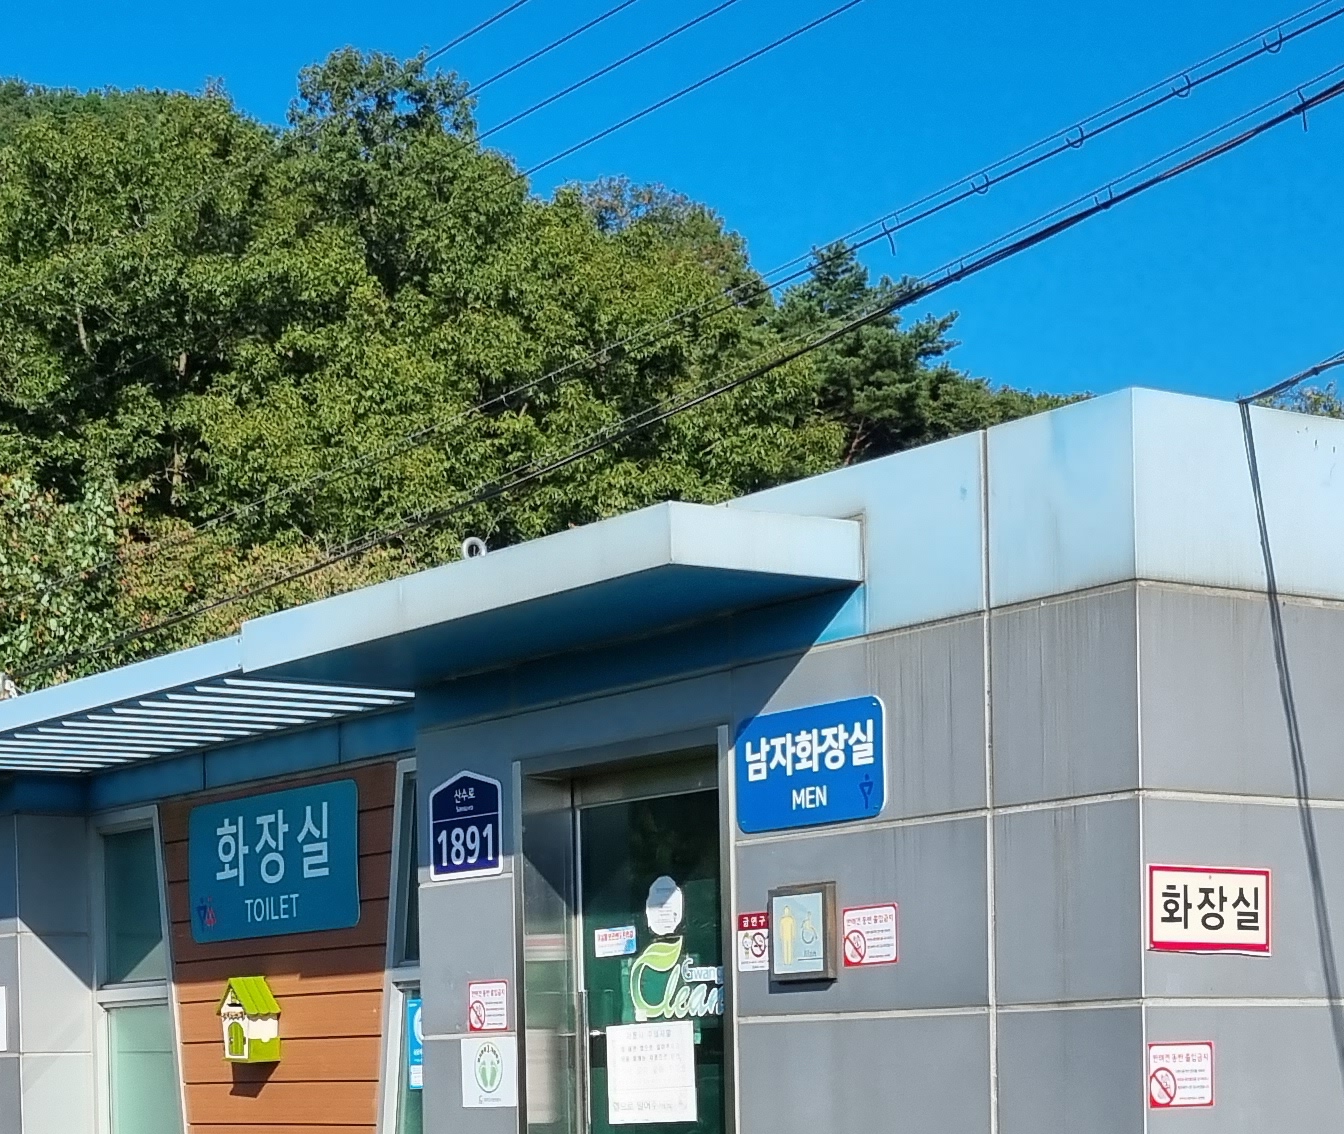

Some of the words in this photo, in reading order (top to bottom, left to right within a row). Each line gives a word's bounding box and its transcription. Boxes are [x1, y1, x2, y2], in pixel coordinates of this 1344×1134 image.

[745, 719, 875, 782] 남자화장실
[792, 785, 828, 811] MEN
[216, 801, 330, 887] 화장실
[437, 823, 494, 867] 1891
[244, 893, 300, 923] TOILET
[742, 915, 766, 928] 금연구
[1161, 884, 1260, 931] 화장실
